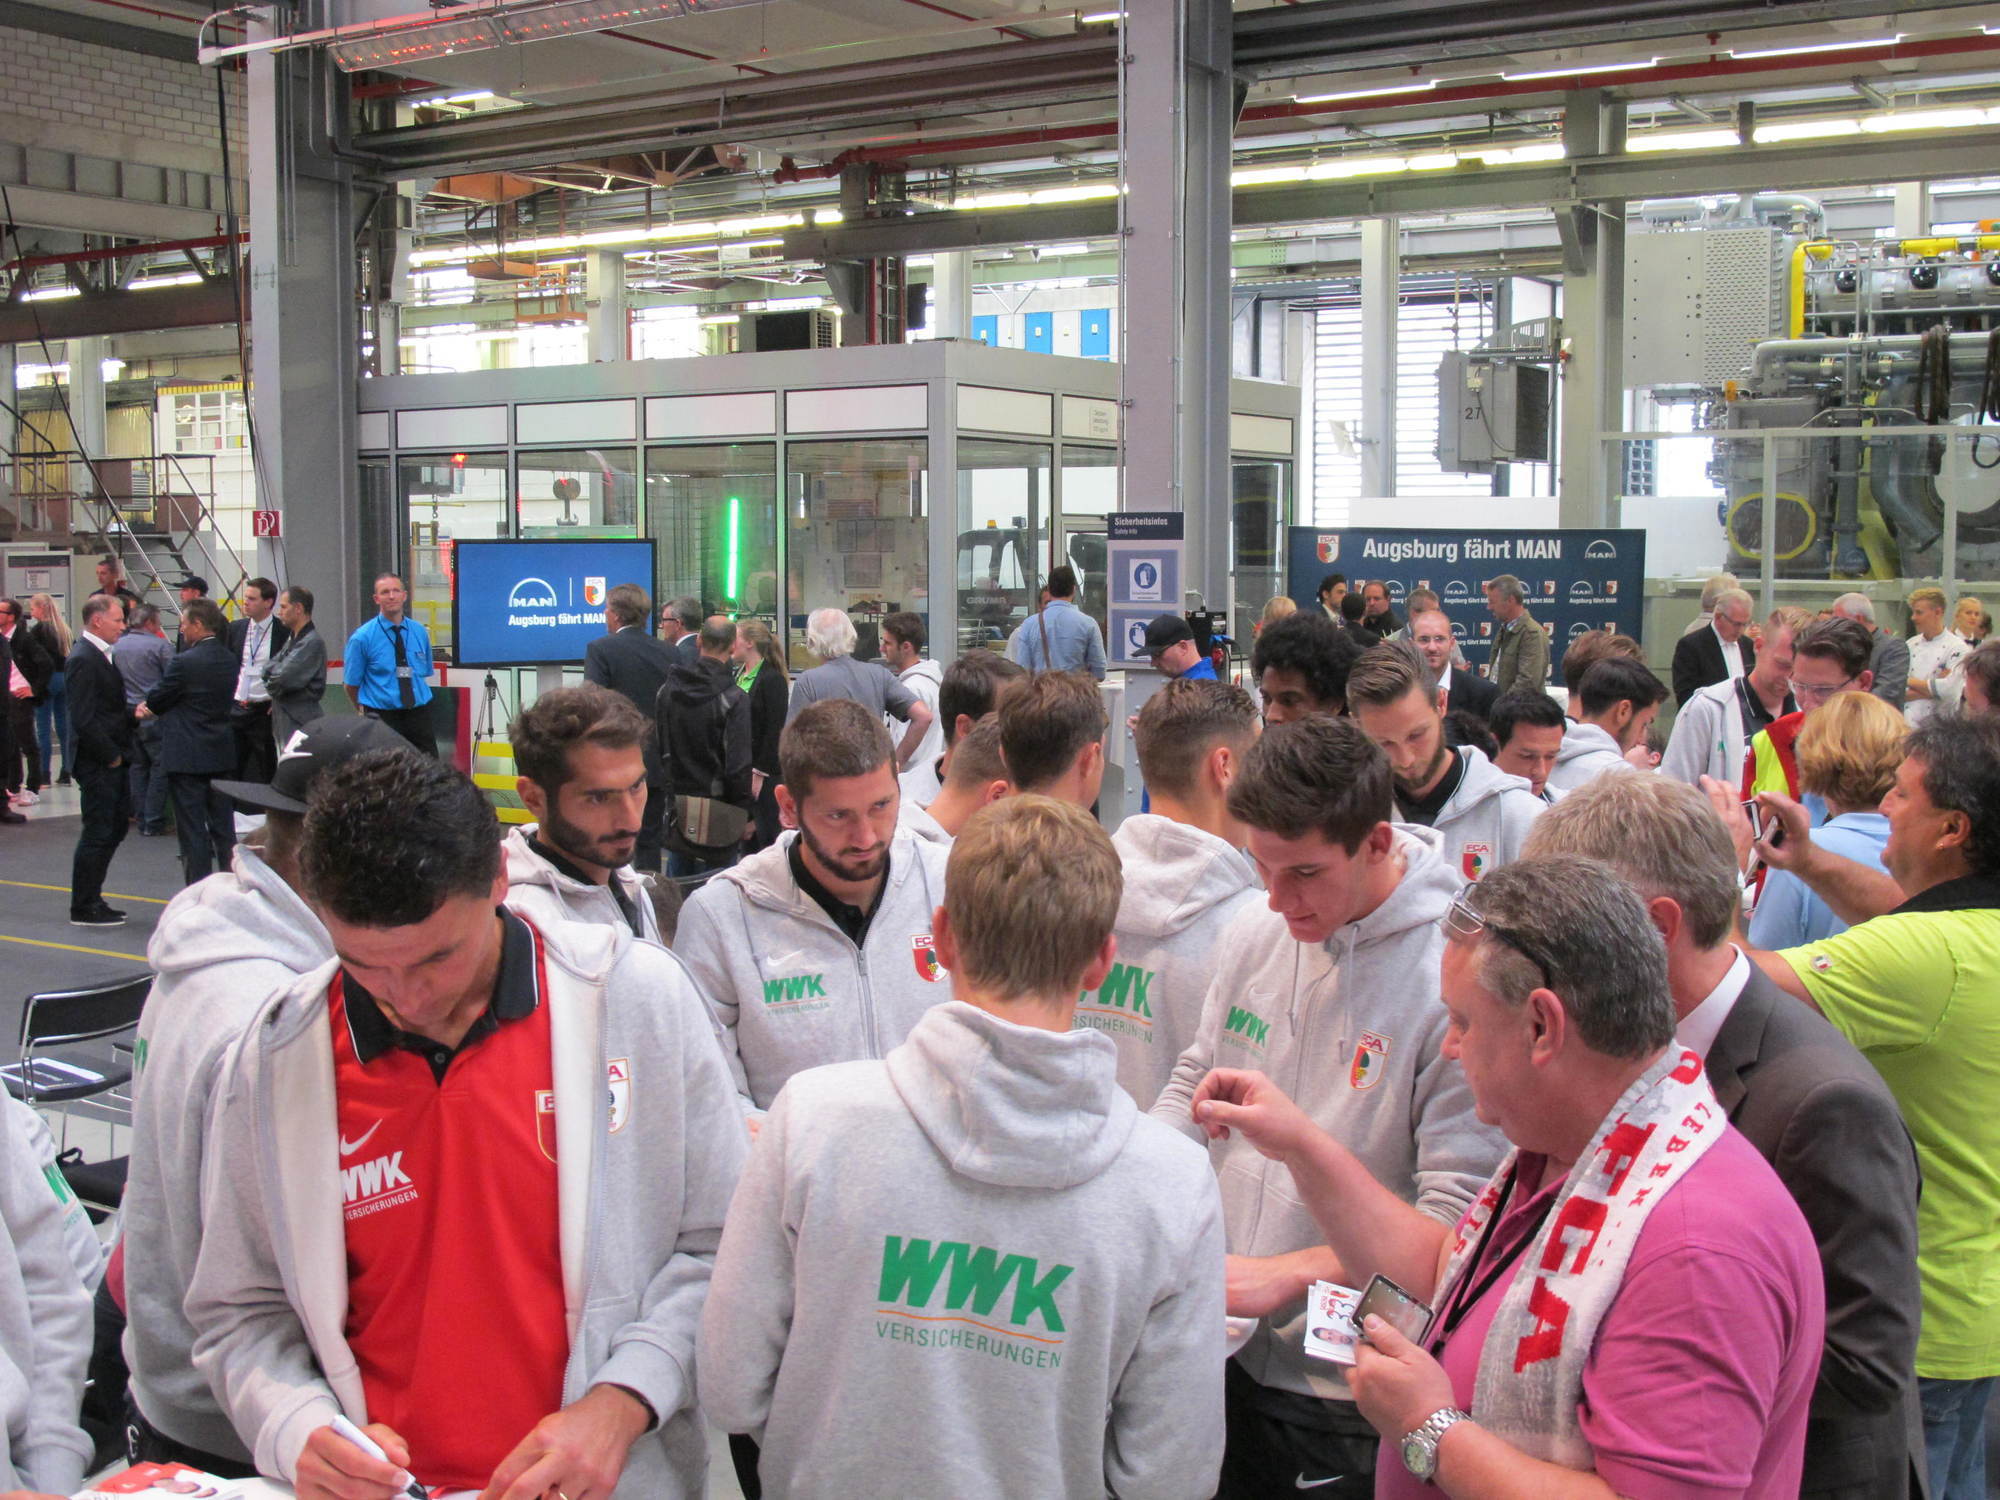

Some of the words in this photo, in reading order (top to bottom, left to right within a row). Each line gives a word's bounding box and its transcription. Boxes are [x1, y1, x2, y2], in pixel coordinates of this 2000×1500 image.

[1465, 407, 1481, 420] 27
[1114, 517, 1168, 526] Sicherheitsinfos
[1362, 538, 1458, 563] Augsburg
[1463, 538, 1511, 559] fährt
[1516, 539, 1561, 559] MAN
[512, 598, 553, 607] MAN
[508, 614, 556, 628] Augsburg
[558, 613, 581, 624] fährt
[583, 613, 606, 624] MAN
[1466, 844, 1488, 852] FCA
[915, 936, 933, 948] FC
[763, 973, 826, 1004] WWK
[1079, 962, 1155, 1018] WK
[1071, 1014, 1152, 1044] RSICHERUNGEN
[1513, 1122, 1657, 1374] FCA
[878, 1234, 1075, 1333] WWK
[876, 1320, 1062, 1369] VERSICHERUNGEN
